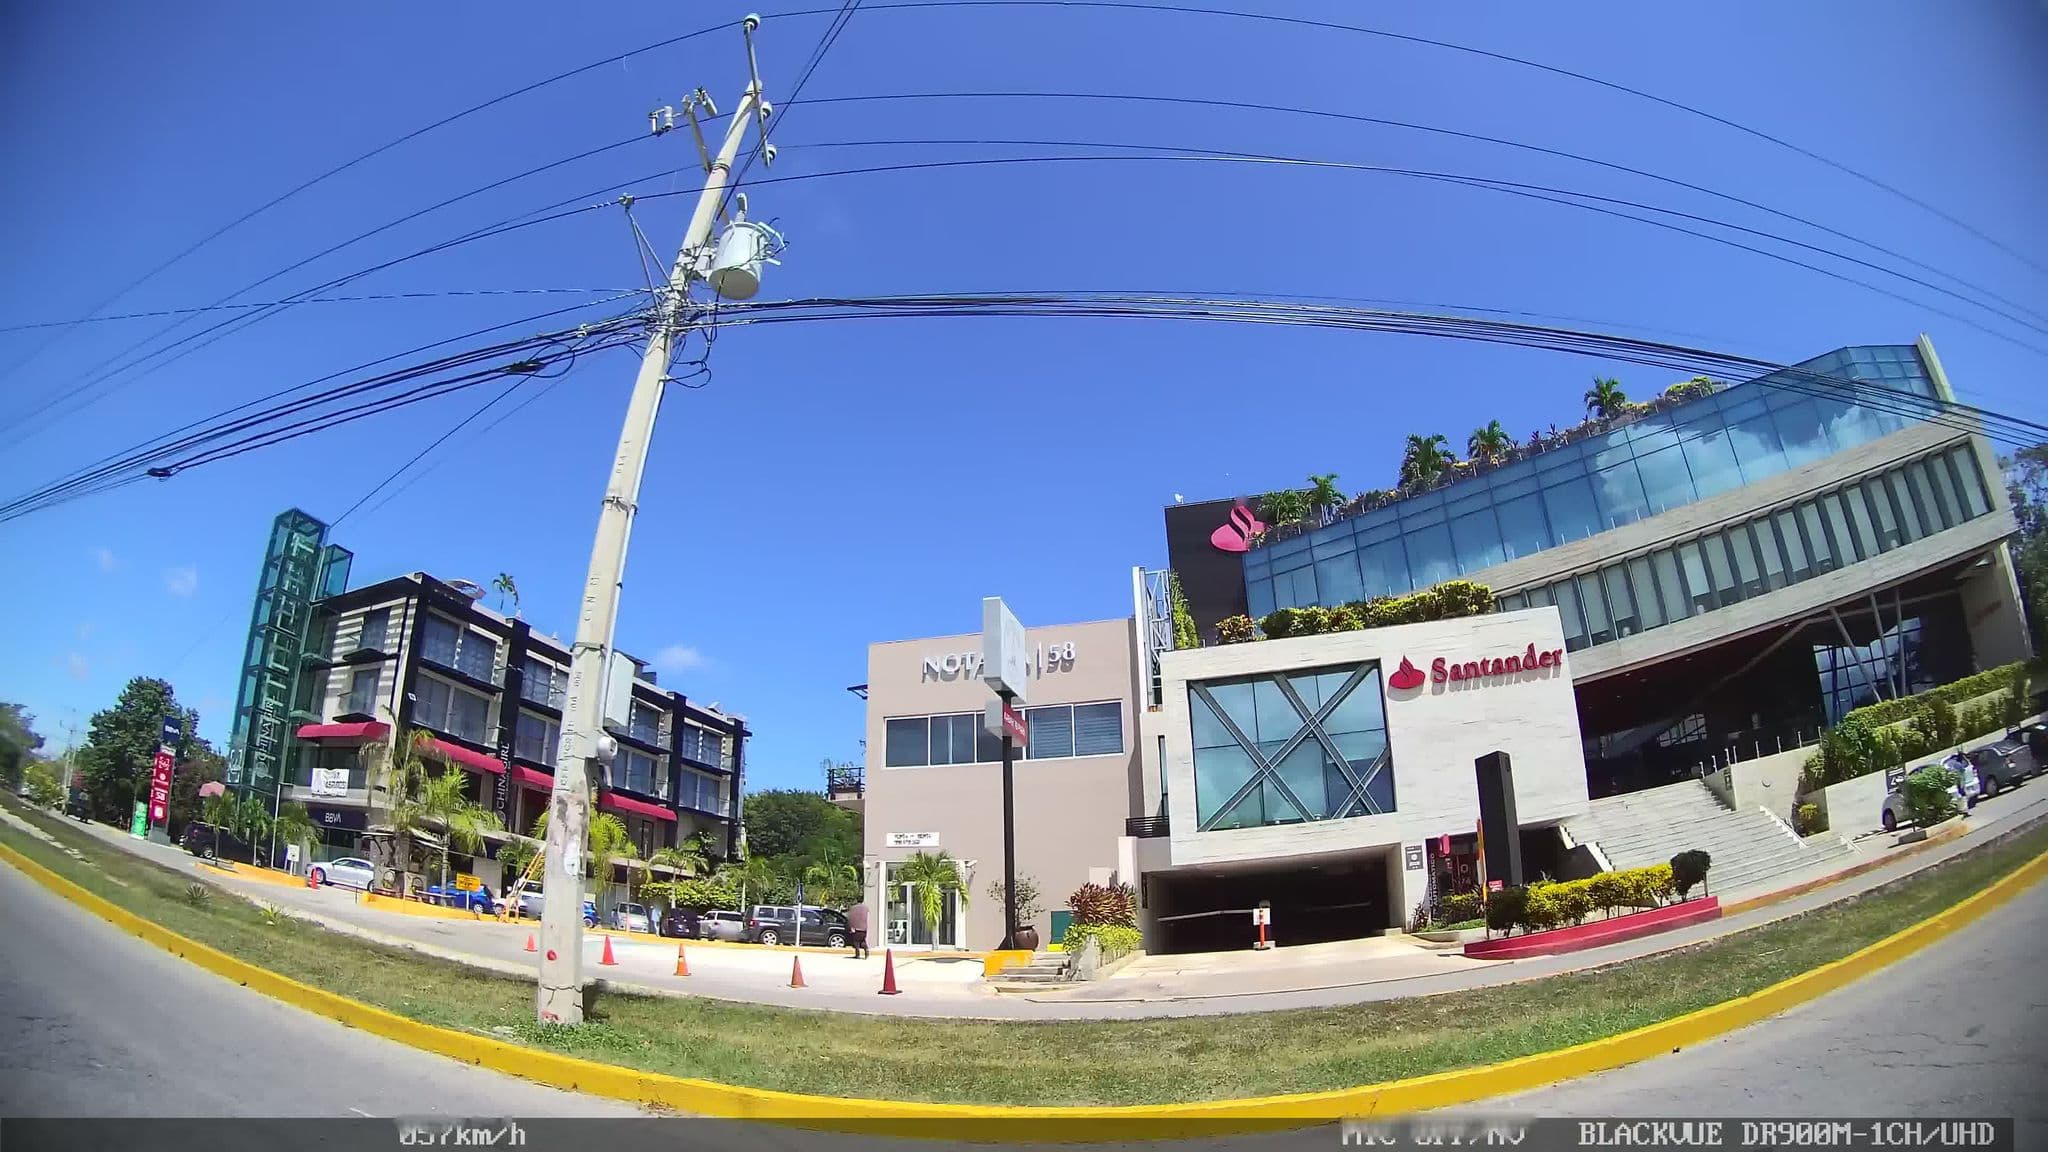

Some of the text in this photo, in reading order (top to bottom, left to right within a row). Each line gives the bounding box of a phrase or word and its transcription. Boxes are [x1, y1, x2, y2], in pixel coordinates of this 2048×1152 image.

[1049, 641, 1076, 662] 58
[1431, 643, 1562, 683] Santander
[325, 812, 342, 824] BBVA
